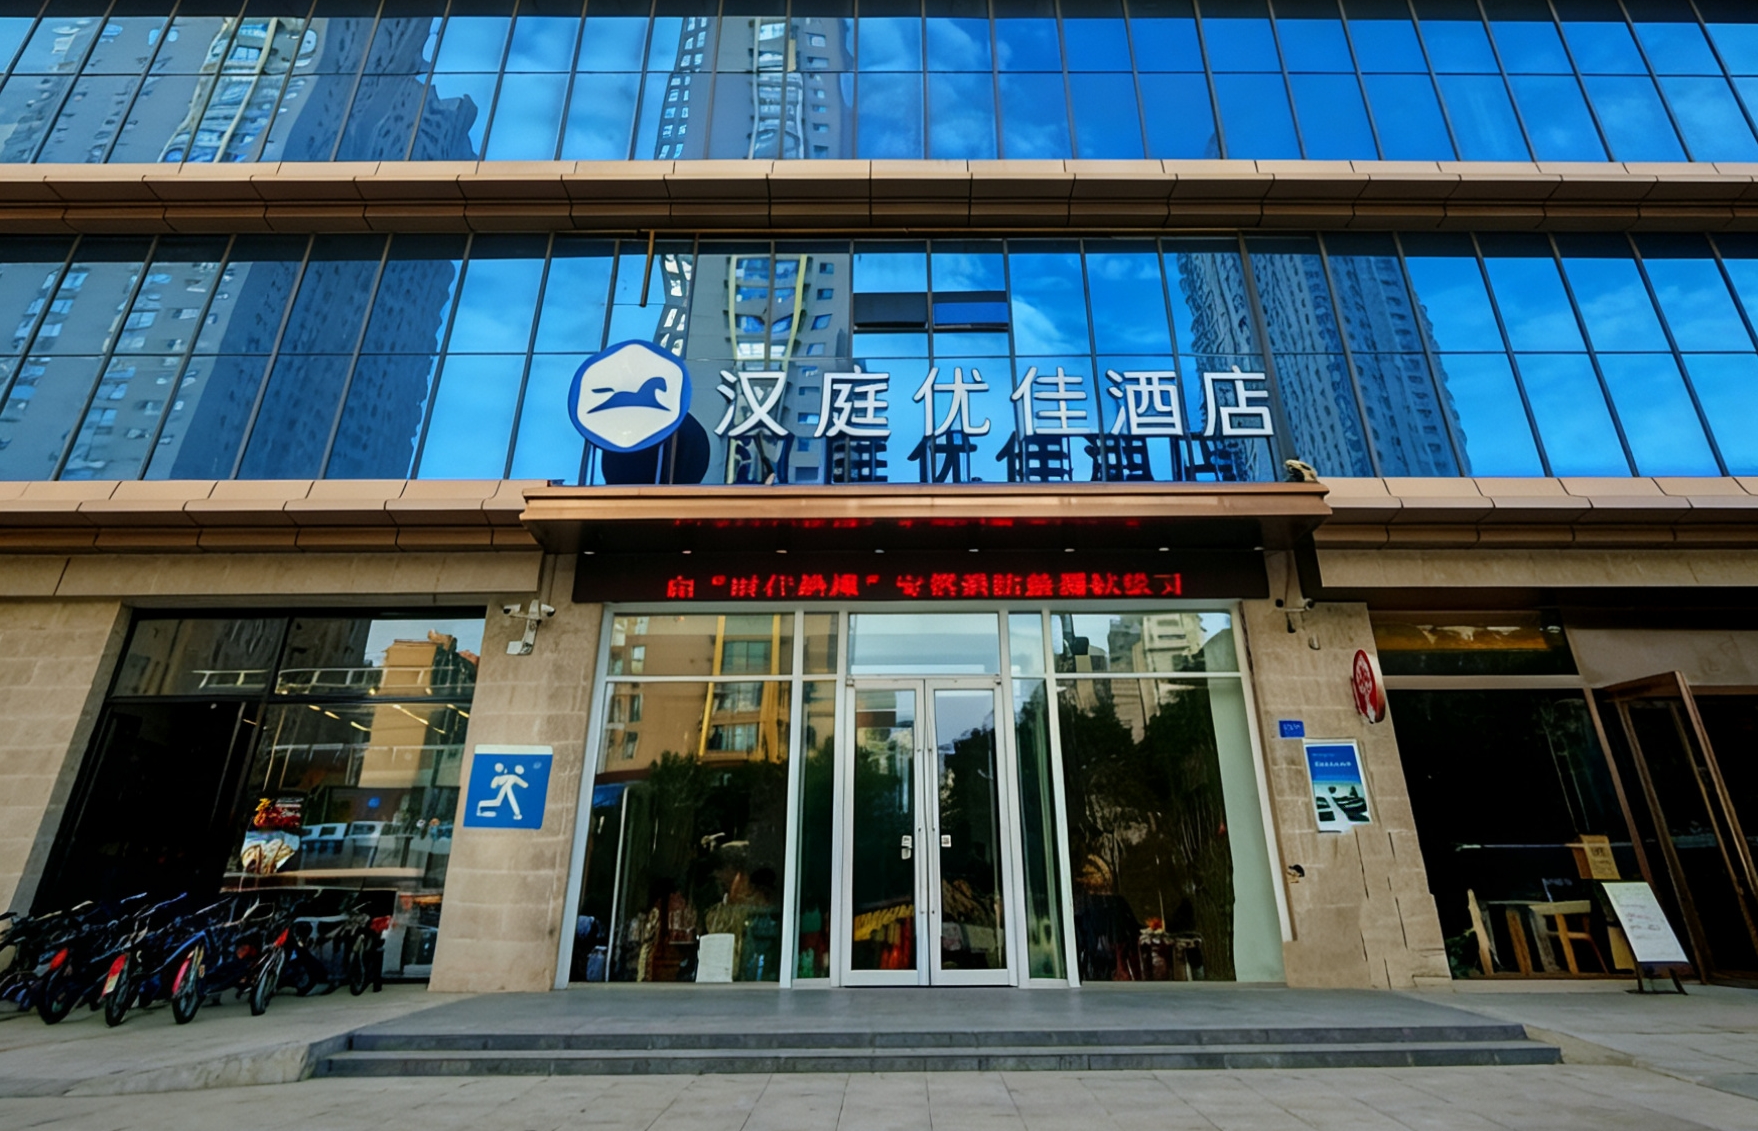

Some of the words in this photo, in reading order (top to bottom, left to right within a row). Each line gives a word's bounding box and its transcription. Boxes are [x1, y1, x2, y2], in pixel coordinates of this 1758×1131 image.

[713, 365, 1276, 438] 汉庭优佳酒店
